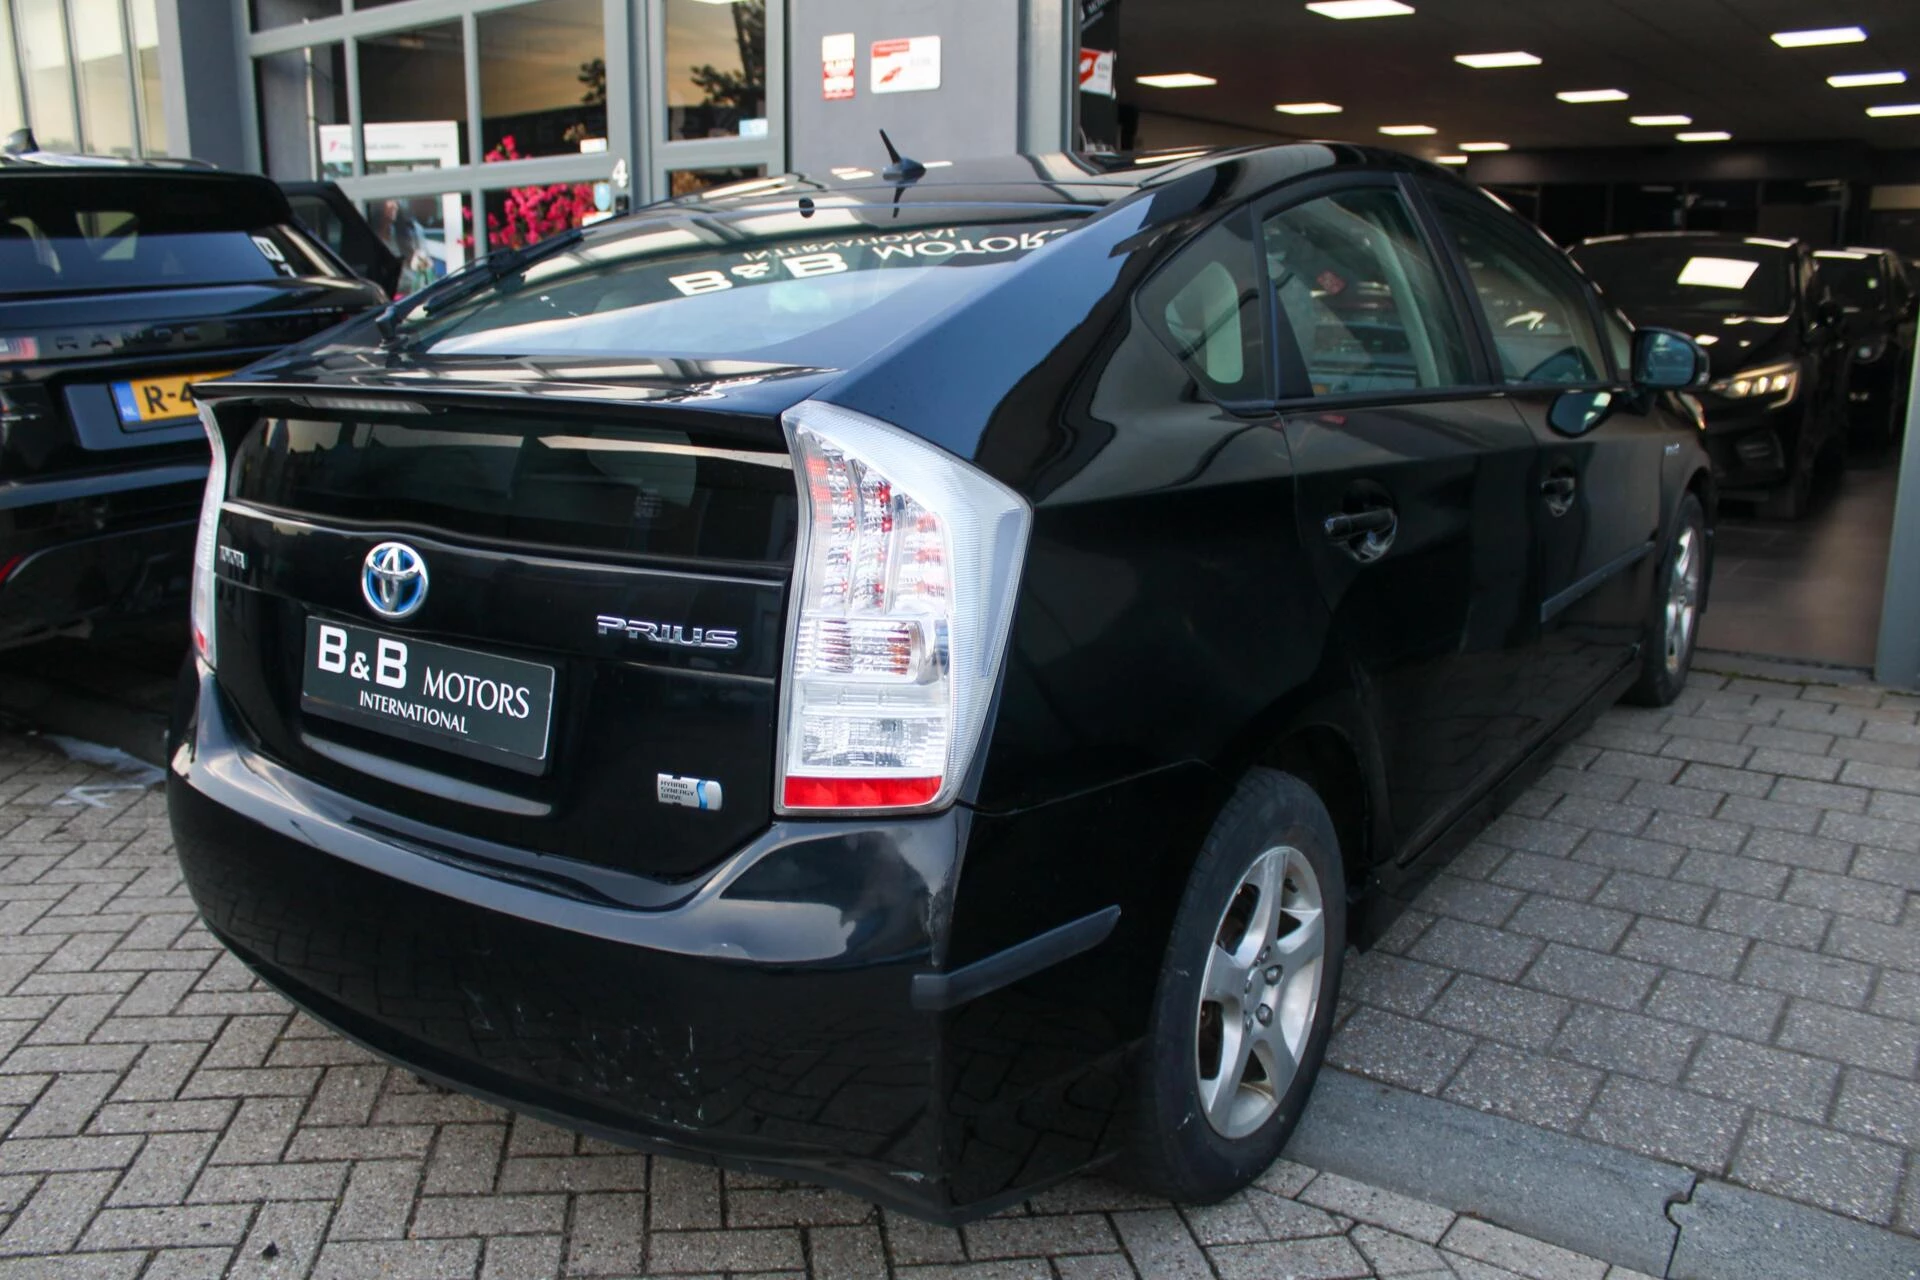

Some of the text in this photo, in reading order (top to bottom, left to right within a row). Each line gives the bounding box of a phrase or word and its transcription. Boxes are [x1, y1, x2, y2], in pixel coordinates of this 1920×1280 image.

[612, 158, 628, 188] 4
[596, 615, 738, 649] PRIUS
[359, 690, 468, 734] INTERNATIONAL
[423, 666, 530, 719] MOTORS
